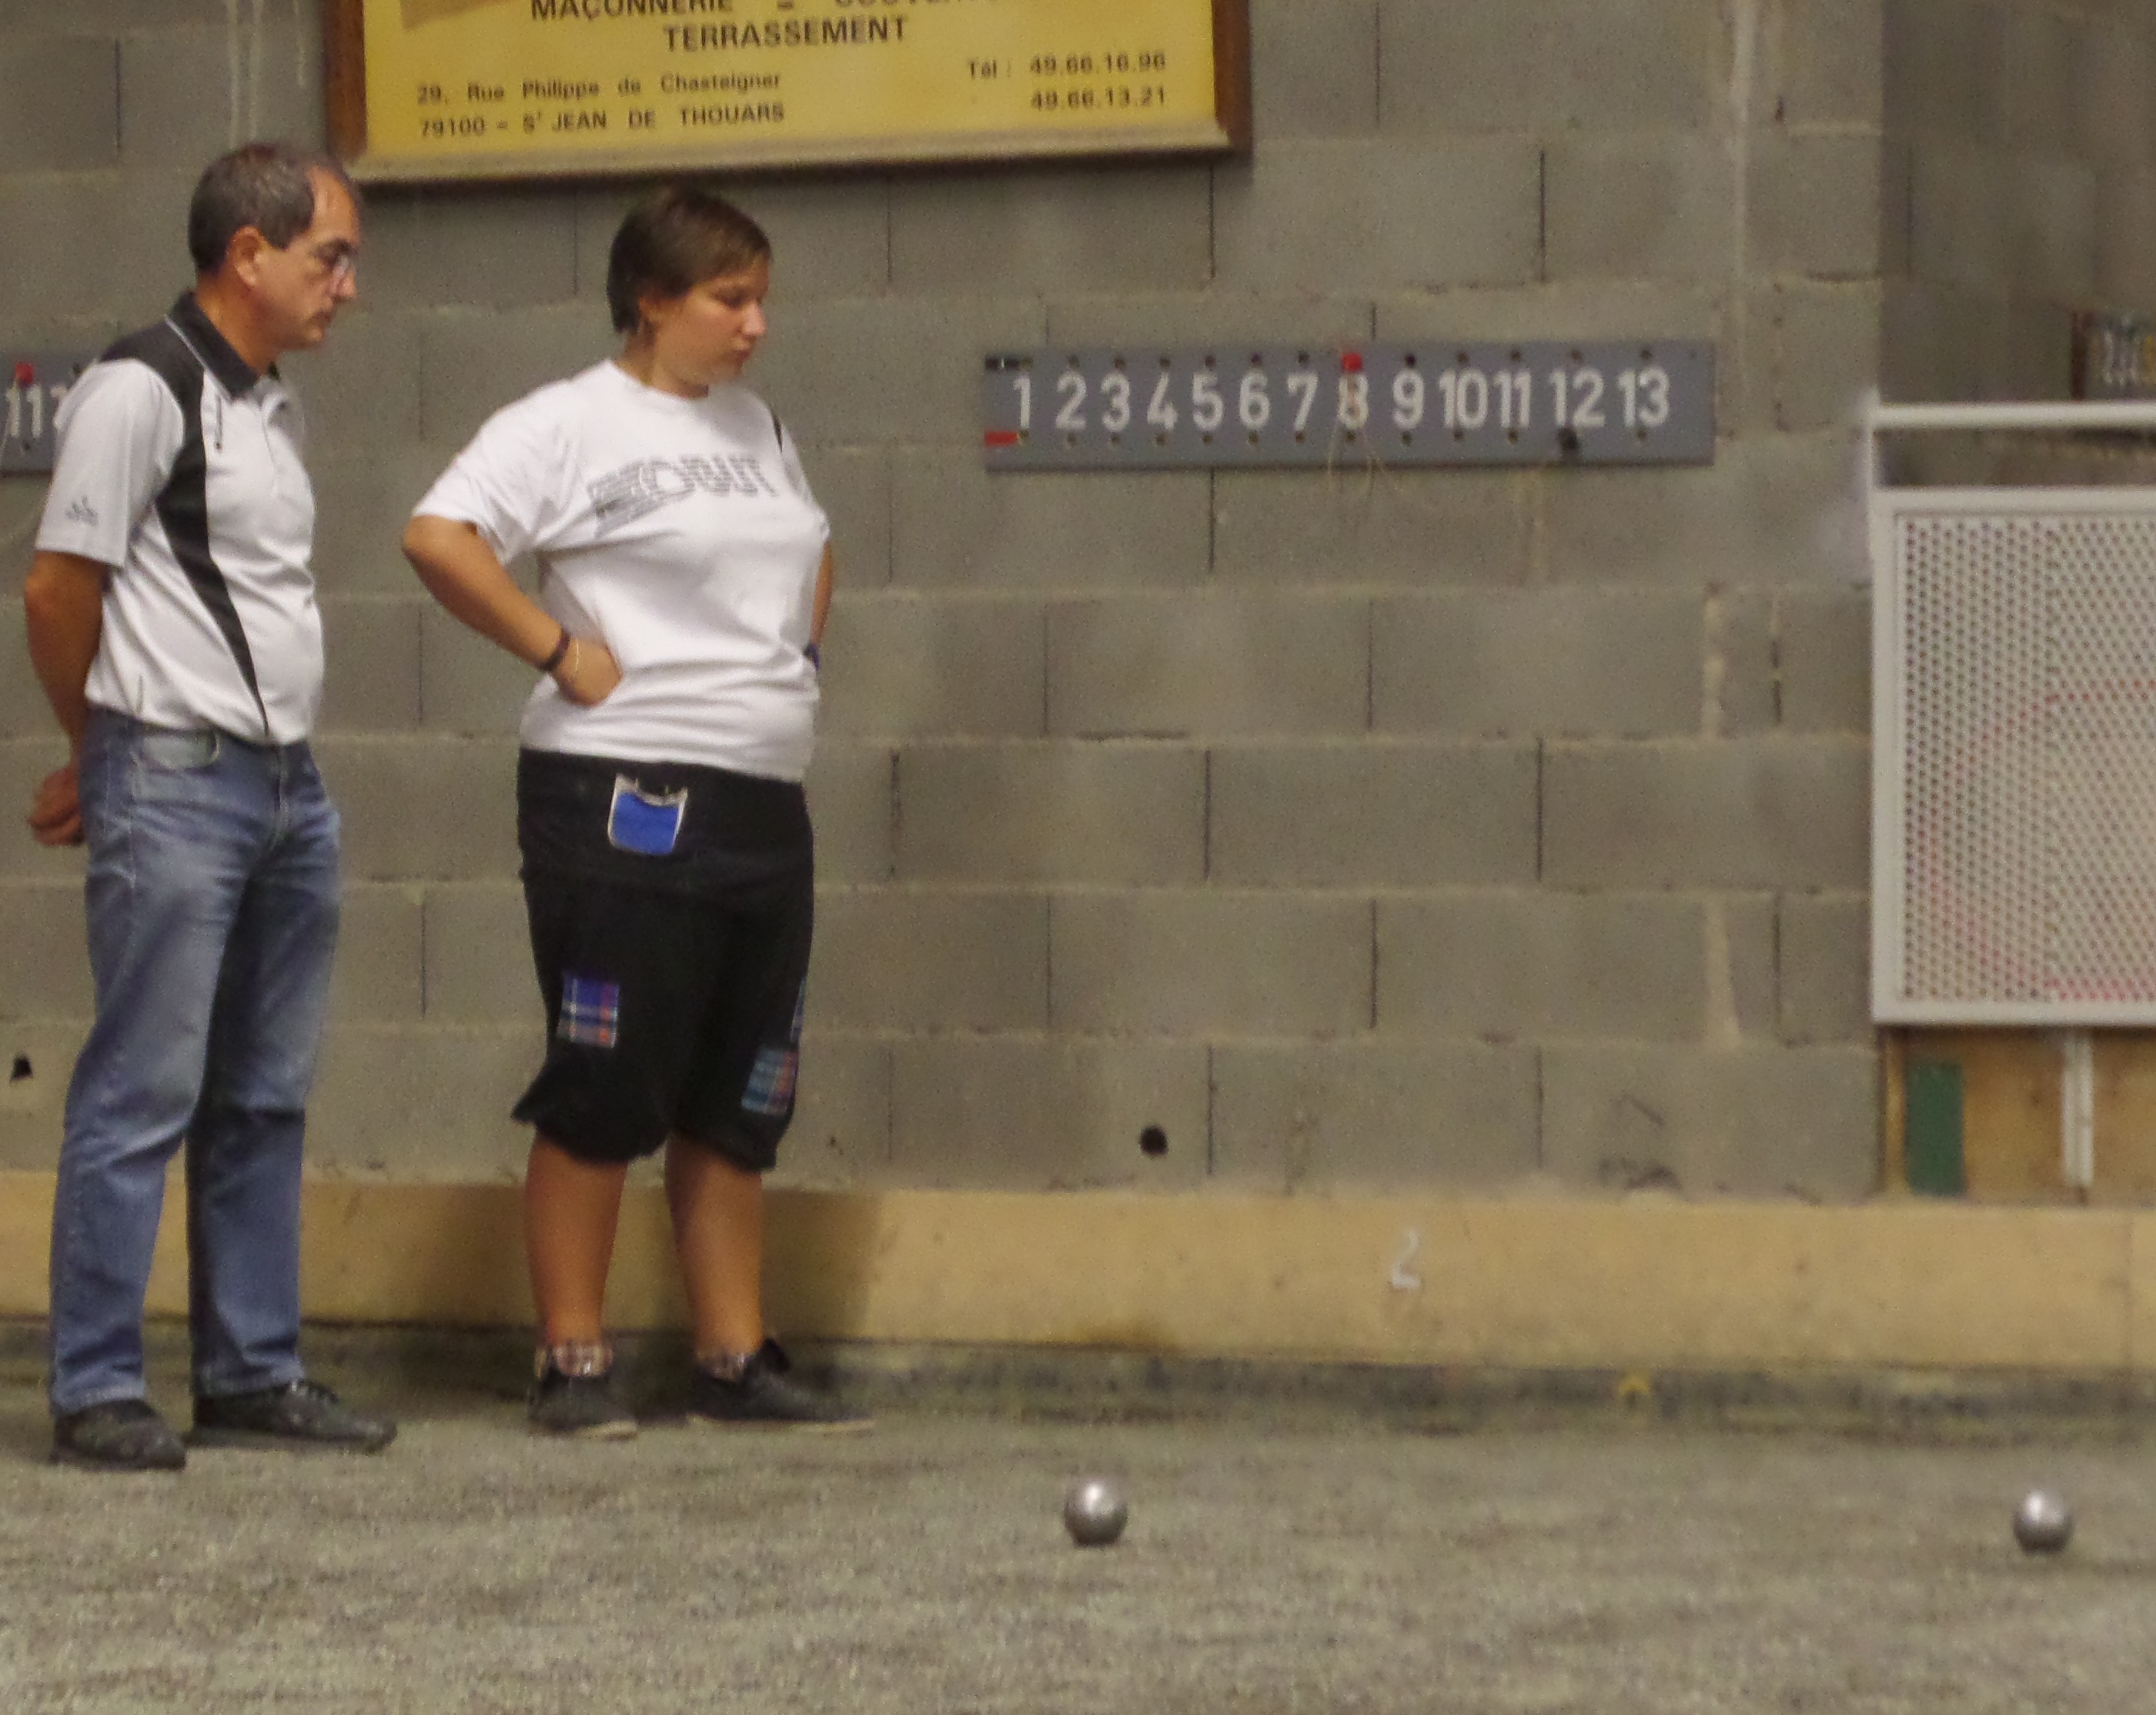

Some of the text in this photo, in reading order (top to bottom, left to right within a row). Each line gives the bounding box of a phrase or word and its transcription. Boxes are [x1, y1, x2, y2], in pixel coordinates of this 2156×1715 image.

[664, 15, 909, 52] TERRASSEMENT
[467, 81, 505, 102] Rue
[523, 79, 600, 101] Philippe
[618, 75, 641, 95] de
[422, 115, 486, 139] 79100
[553, 110, 607, 132] JEAN
[628, 107, 655, 130] DE
[681, 102, 784, 127] THOUARS
[1013, 366, 1671, 432] 1 2 3 4 5 6 7 8 9 10 11 12 13
